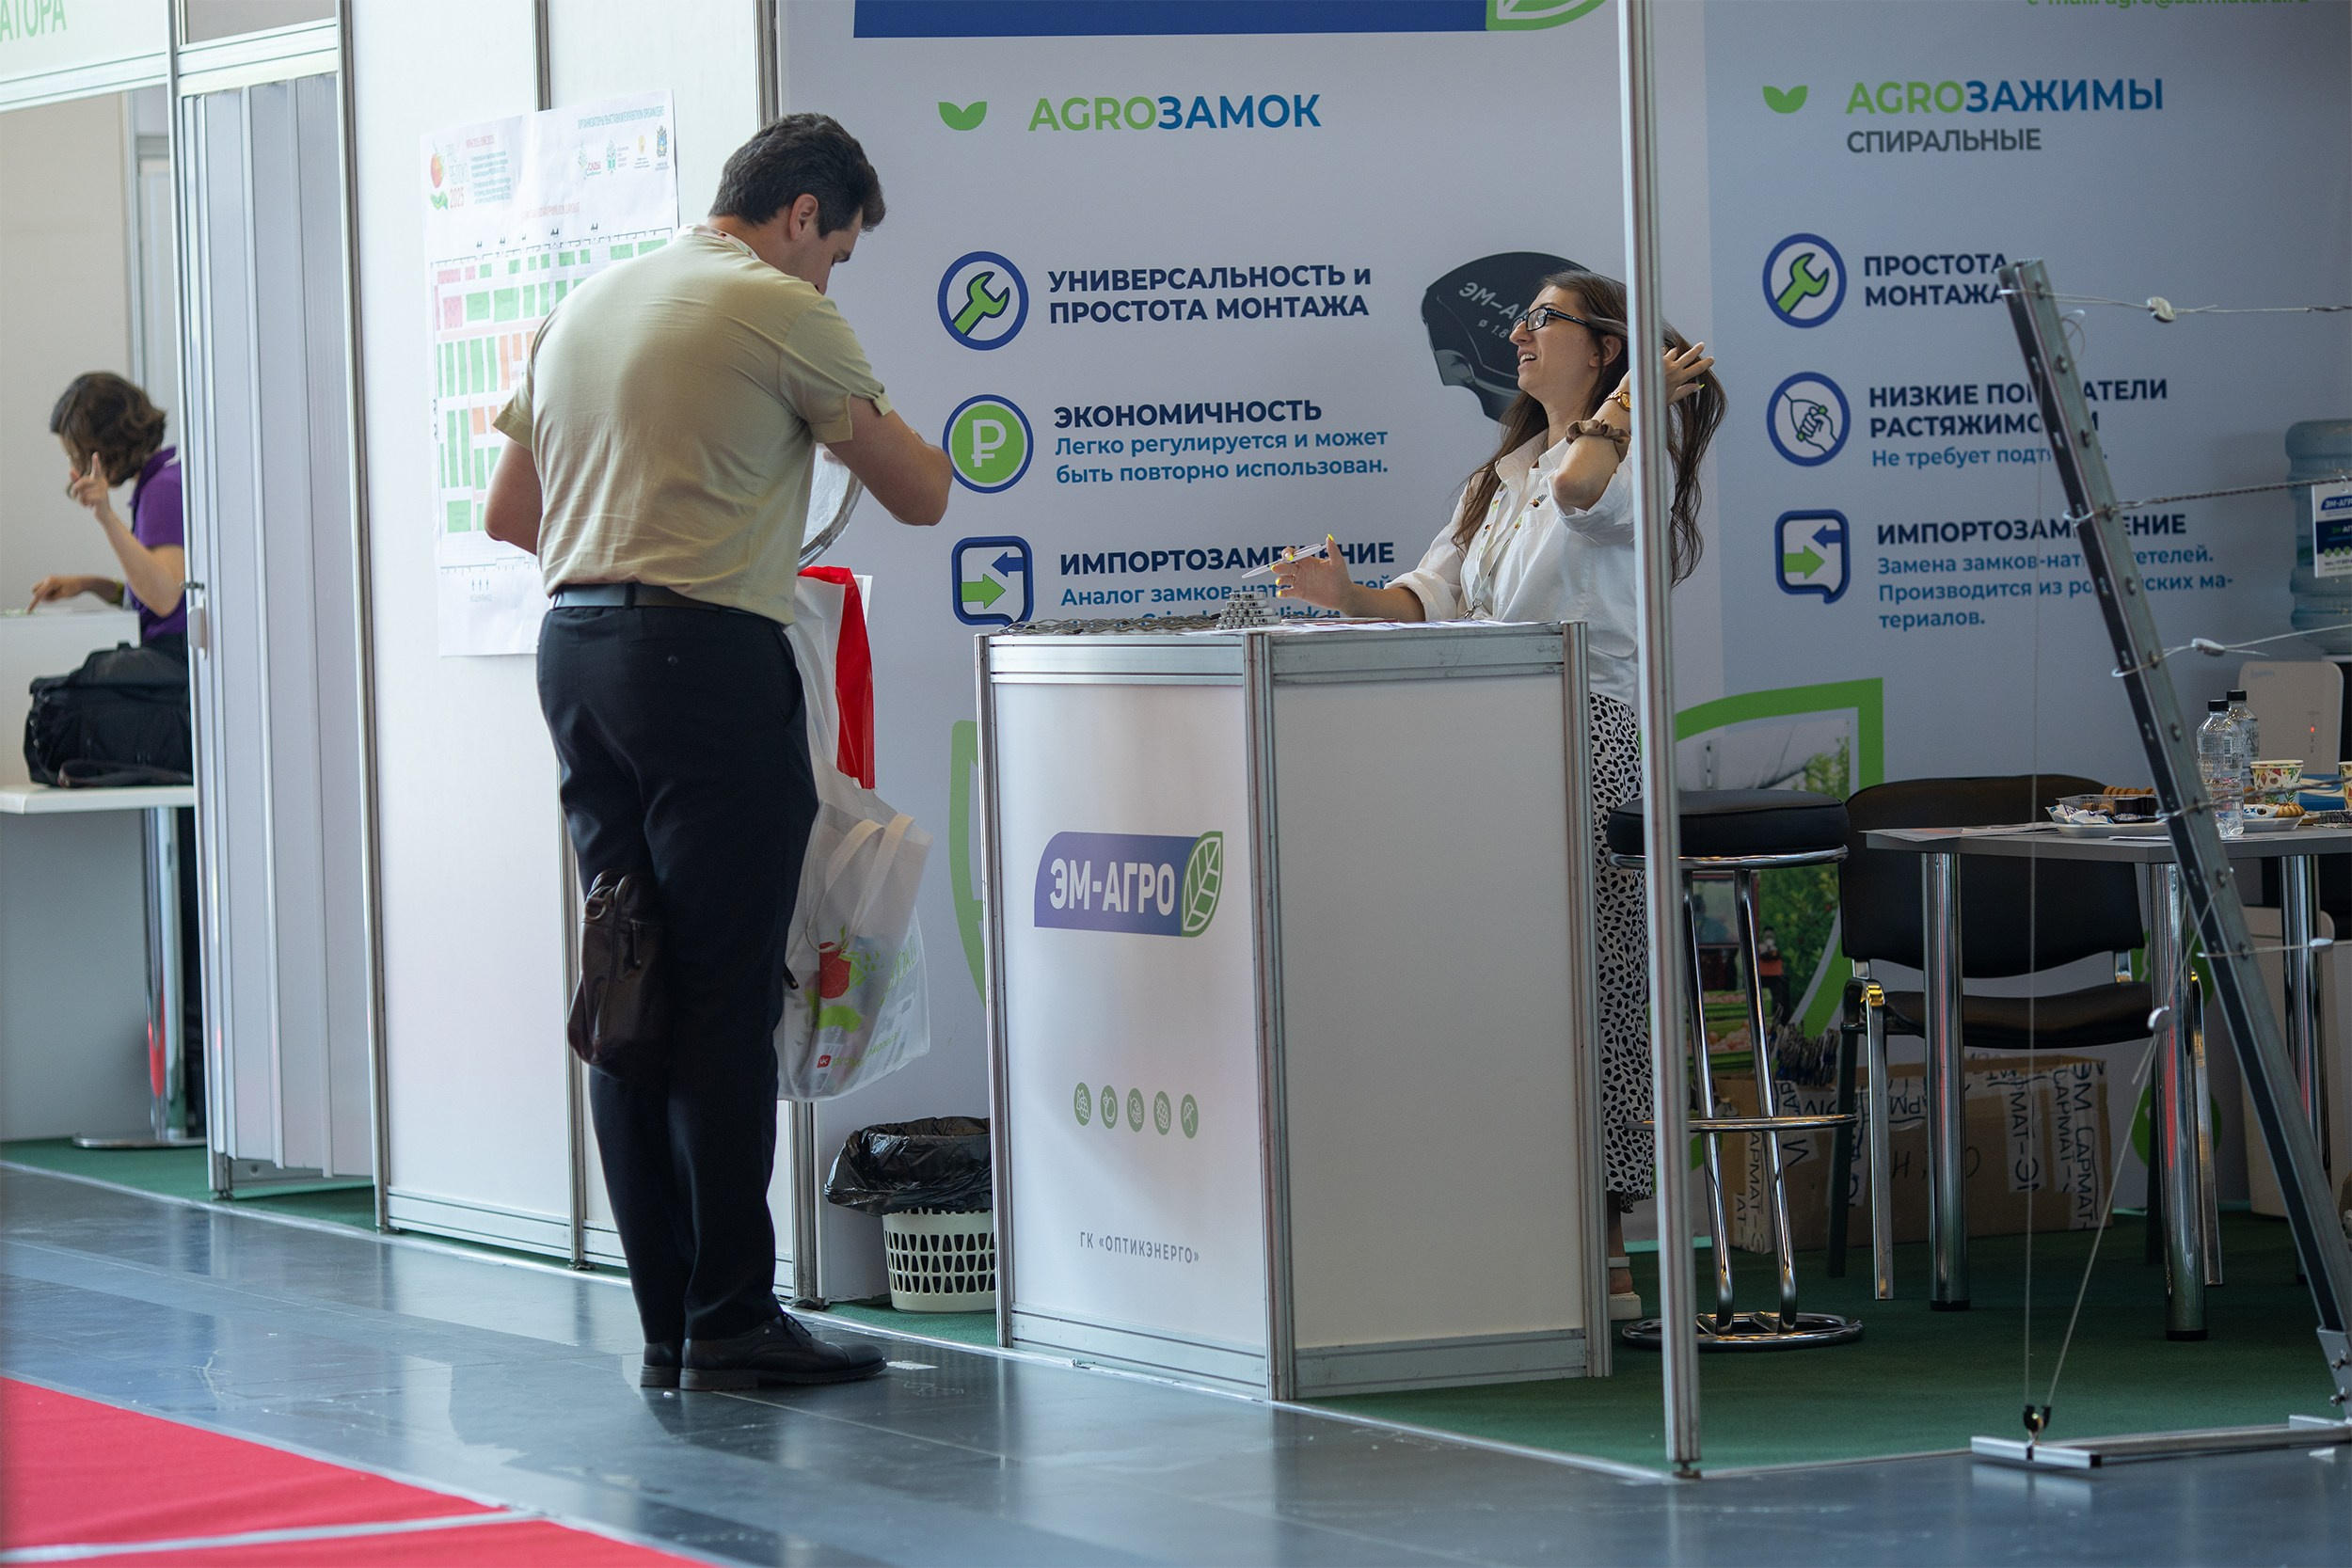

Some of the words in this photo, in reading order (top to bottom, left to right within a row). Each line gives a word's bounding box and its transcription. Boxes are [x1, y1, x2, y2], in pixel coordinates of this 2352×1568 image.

[1845, 78, 2163, 115] AGROЗАЖИМЫ
[1027, 94, 1322, 132] AGROЗАМОК
[1847, 128, 2042, 153] СПИРАЛЬНЫЕ
[1047, 264, 1345, 293] УНИВЕРСАЛЬНОСТЬ
[1864, 253, 2007, 277] ПРОСТОТА
[1050, 298, 1208, 324] ПРОСТОТА
[1216, 294, 1369, 320] МОНТАЖА
[1865, 284, 2004, 307] МОНТАЖА
[1869, 385, 1979, 408] НИЗКИЕ
[1987, 378, 2168, 404] ПОАТЕЛИ
[1054, 400, 1322, 429] ЭКОНОМИЧНОСТЬ
[1870, 411, 2099, 438] РАСТЯЖИМО
[1055, 437, 1124, 456] Легко
[1131, 435, 1287, 457] регулируется
[1295, 434, 1308, 448] и
[1315, 431, 1389, 447] может
[1872, 450, 1900, 467] Не
[1906, 447, 1991, 469] требует
[1056, 464, 1114, 483] быть
[1120, 464, 1230, 483] повторно
[1236, 459, 1389, 478] использован.
[1877, 514, 2186, 546] ИМПОРТОЗАМНИЕ
[1060, 542, 1395, 576] ИМПОРТОЗАМЕНИЕ
[1877, 557, 1957, 575] Замена
[1060, 588, 1145, 607] Аналог
[1879, 581, 2032, 605] Производится
[2040, 580, 2063, 595] из
[2070, 575, 2194, 599] роских
[2200, 574, 2233, 589] ма-
[1879, 610, 1986, 632] териалов.
[1049, 858, 1175, 916] ЭМ-АГРО
[2053, 1069, 2075, 1193] САРМАТ-
[1080, 1231, 1093, 1249] ГК
[1099, 1235, 1200, 1263] «ОПТИКЭНЕРГО»
